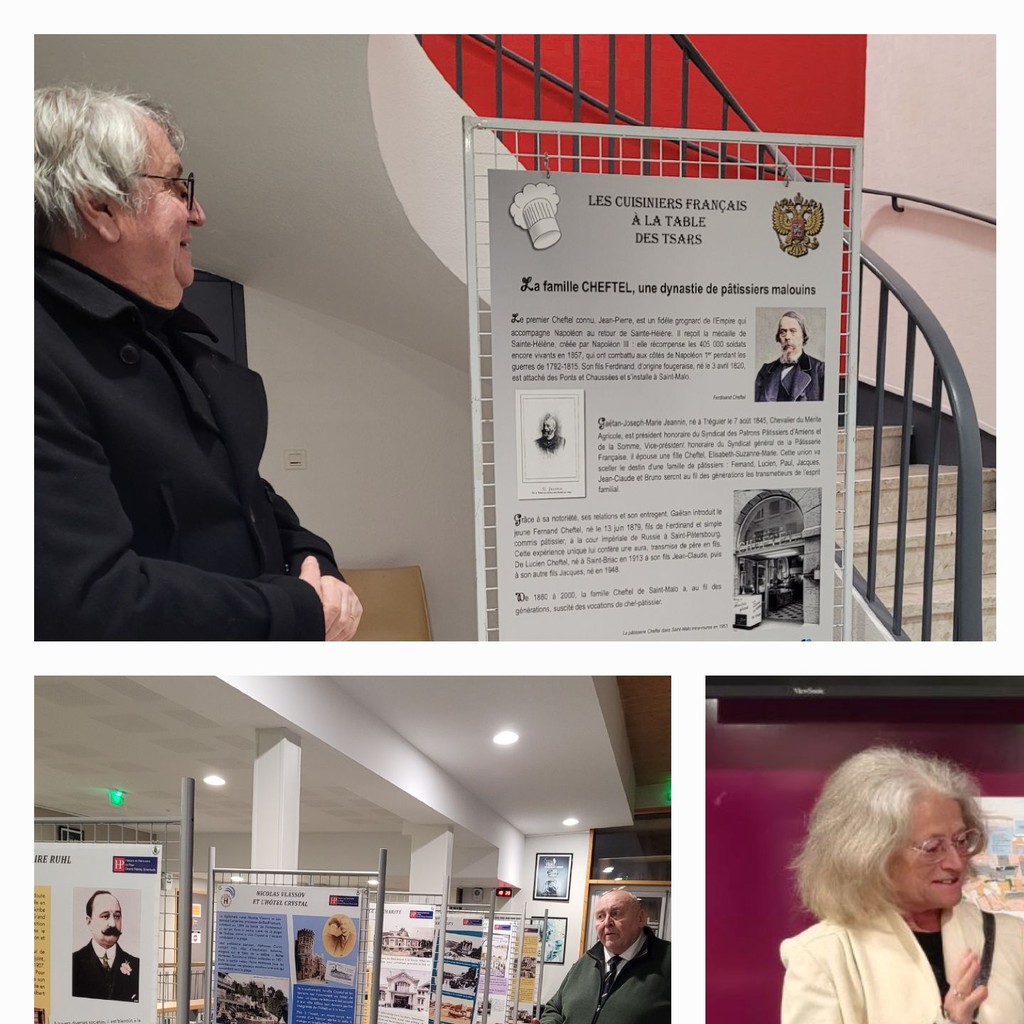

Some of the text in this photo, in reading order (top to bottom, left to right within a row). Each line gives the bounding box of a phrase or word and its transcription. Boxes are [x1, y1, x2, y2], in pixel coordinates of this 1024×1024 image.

[588, 194, 747, 213] LES CUISINIERS FRANÇAIS
[631, 212, 706, 227] À LA TABLE
[635, 232, 702, 245] DES TSARS
[520, 277, 816, 297] La famille CHEFTEL, une dynastie de pâtissiers malouins
[525, 315, 550, 324] premier
[551, 315, 573, 324] Cheftel
[635, 316, 645, 324] est
[656, 316, 673, 324] fidèle
[674, 317, 701, 326] grognard
[737, 318, 746, 326] qui
[510, 329, 550, 338] accompagne
[553, 329, 583, 338] Napoléon
[597, 329, 616, 337] retour
[618, 329, 627, 337] de
[683, 330, 700, 339] reçoit
[703, 329, 708, 337] la
[738, 329, 746, 337] de
[49, 855, 72, 864] RUHL
